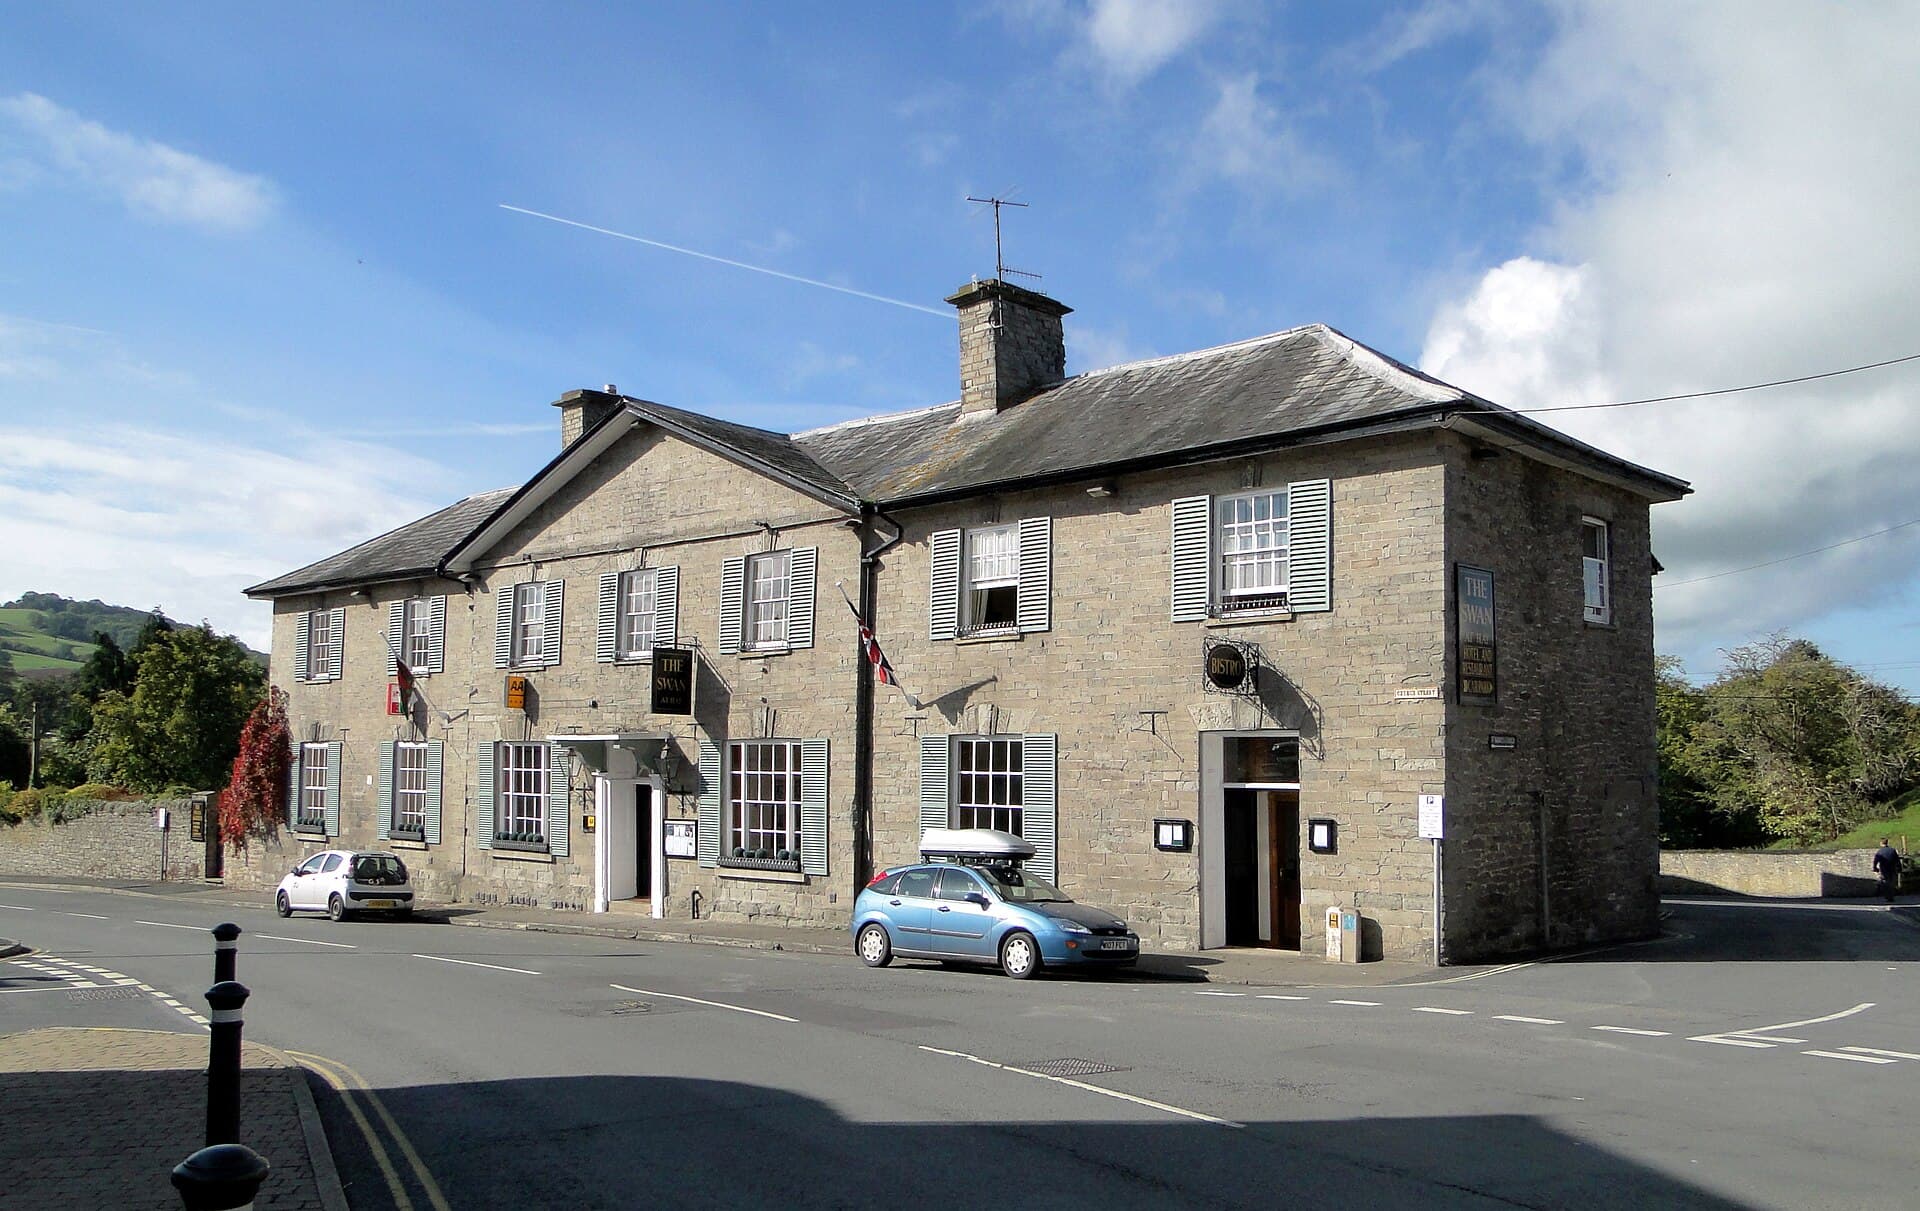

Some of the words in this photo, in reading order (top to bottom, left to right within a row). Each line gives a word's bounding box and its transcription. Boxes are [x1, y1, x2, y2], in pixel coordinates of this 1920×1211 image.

[1464, 576, 1488, 599] THE
[1461, 603, 1492, 625] SWAN
[661, 658, 684, 672] THE
[1211, 657, 1242, 677] BISTRO
[511, 680, 524, 691] AA
[656, 677, 687, 692] SWAN
